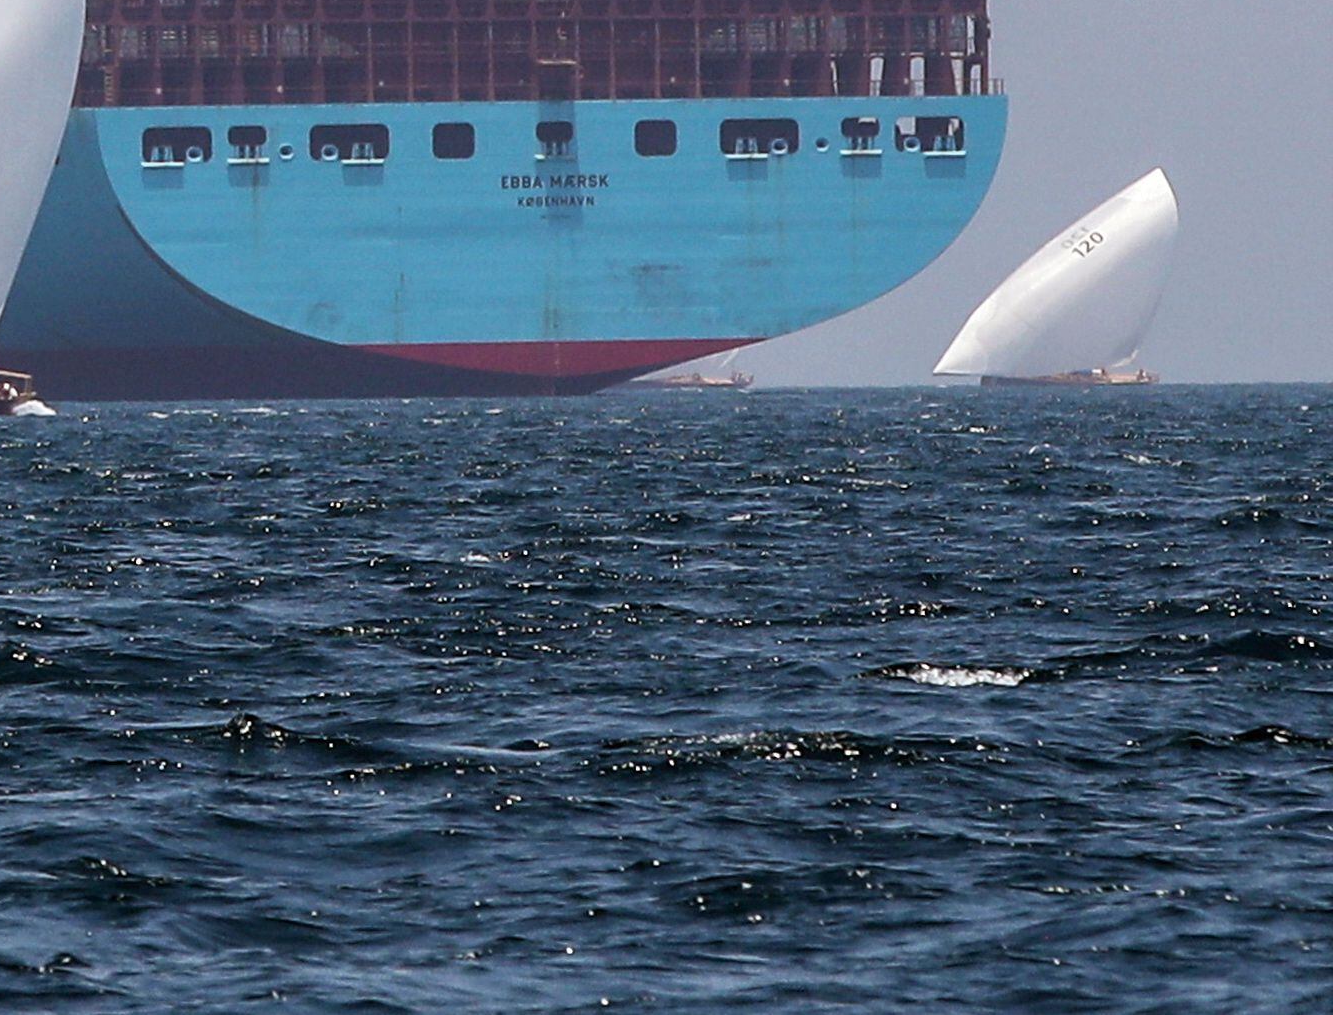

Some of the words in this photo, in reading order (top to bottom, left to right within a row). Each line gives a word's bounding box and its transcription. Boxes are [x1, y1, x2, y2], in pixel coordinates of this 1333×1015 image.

[501, 174, 543, 189] EBBA
[550, 174, 609, 189] MÆRSK
[1071, 232, 1103, 257] 120
